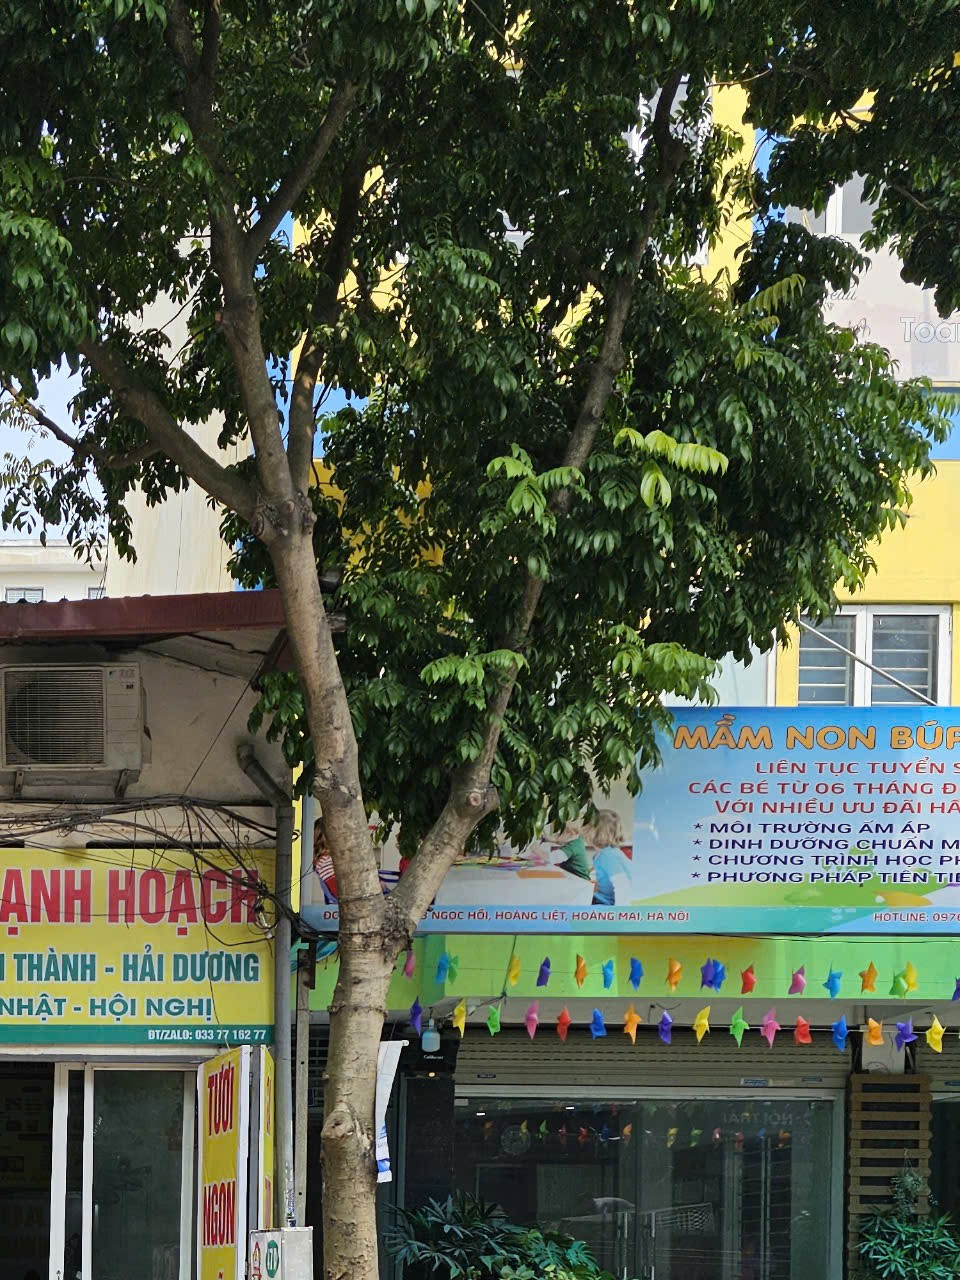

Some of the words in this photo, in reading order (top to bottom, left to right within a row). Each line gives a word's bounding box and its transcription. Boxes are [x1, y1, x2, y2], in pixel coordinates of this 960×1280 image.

[673, 713, 773, 750] MẦM
[785, 725, 877, 750] NON
[756, 759, 806, 774] LIÊN
[814, 762, 860, 777] TỤC
[867, 756, 945, 774] TUYỂN
[688, 780, 732, 795] CÁC
[740, 780, 769, 795] BÉ
[777, 780, 810, 795] TỪ
[815, 782, 845, 795] 06
[854, 779, 934, 795] THÁNG
[715, 799, 754, 814] VỚI
[762, 798, 833, 814] NHIỀU
[842, 801, 875, 814] ƯU
[882, 799, 922, 814] ĐÃI
[710, 820, 752, 834] MÔI
[758, 820, 852, 834] TRƯỜNG
[859, 819, 894, 834] ẤM
[900, 820, 931, 834] ÁP
[709, 839, 763, 850] DINH
[770, 837, 849, 850] DƯỠNG
[856, 835, 934, 850] CHUẨN
[708, 854, 804, 866] CHƯƠNG
[810, 852, 878, 866] TRÌNH
[886, 855, 933, 868] HỌC
[707, 871, 803, 883] PHƯƠNG
[810, 870, 872, 883] PHÁP
[878, 869, 928, 883] TIÊN
[107, 868, 259, 937] HOẠCH
[431, 911, 464, 922] NGỌC
[495, 910, 538, 921] HOÀNG
[572, 910, 615, 921] HOÀNG
[647, 910, 664, 921] HÀ
[668, 910, 689, 921] NỘI
[874, 912, 929, 922] HOTLINE:
[13, 947, 97, 982] THÀNH
[122, 944, 165, 982] HẢI
[172, 950, 260, 982] DƯƠNG
[89, 993, 137, 1022] HỘI
[146, 997, 213, 1022] NGHỊ
[195, 1029, 214, 1040] 033
[216, 1029, 230, 1040] 77
[232, 1029, 252, 1040] 162
[253, 1029, 267, 1040] 77
[207, 1061, 235, 1137] TƯƠI
[203, 1180, 236, 1247] NGON
